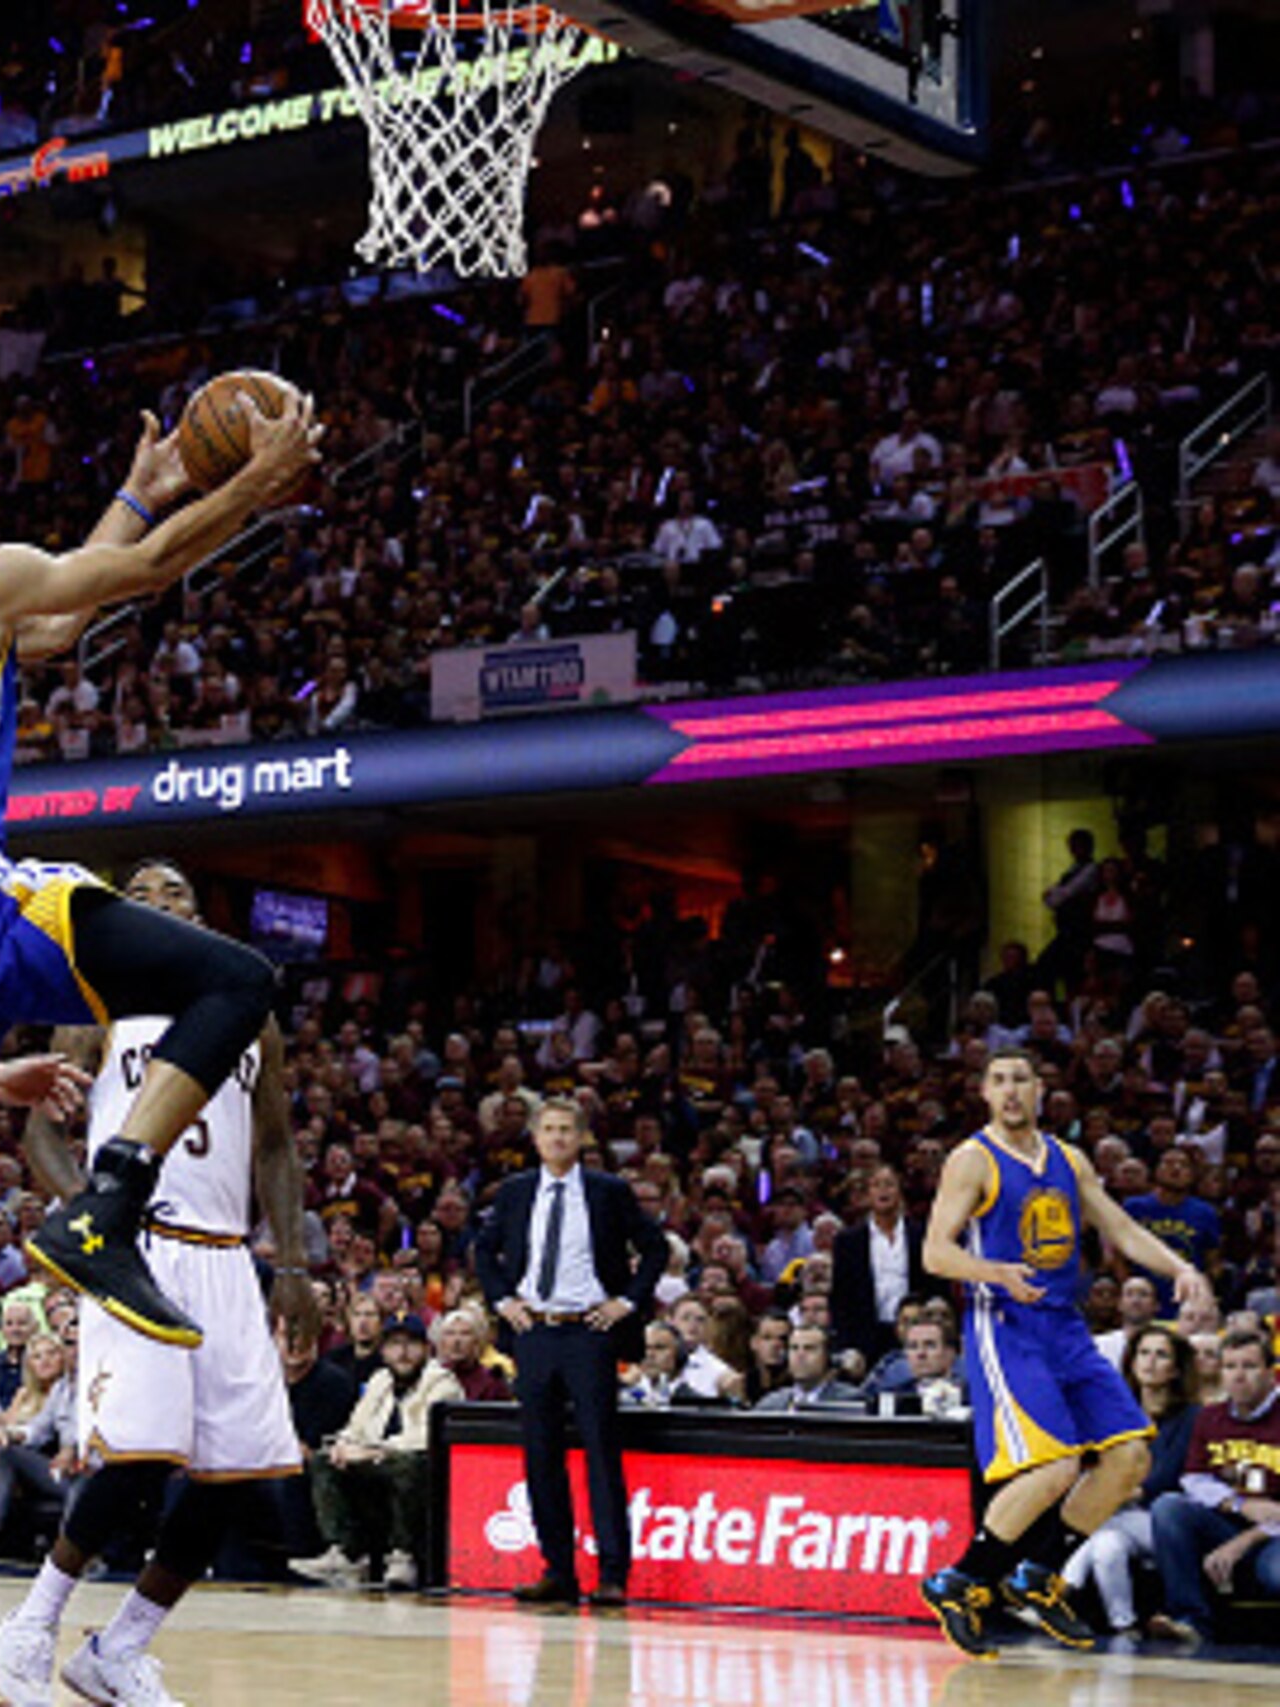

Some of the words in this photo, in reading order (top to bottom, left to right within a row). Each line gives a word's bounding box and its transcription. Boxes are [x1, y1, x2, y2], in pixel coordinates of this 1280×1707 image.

[148, 95, 313, 157] WELCOME
[320, 88, 362, 121] TO
[102, 785, 143, 813] BY
[152, 761, 246, 811] drug
[253, 747, 354, 794] mart
[628, 1487, 930, 1575] tateFarm
